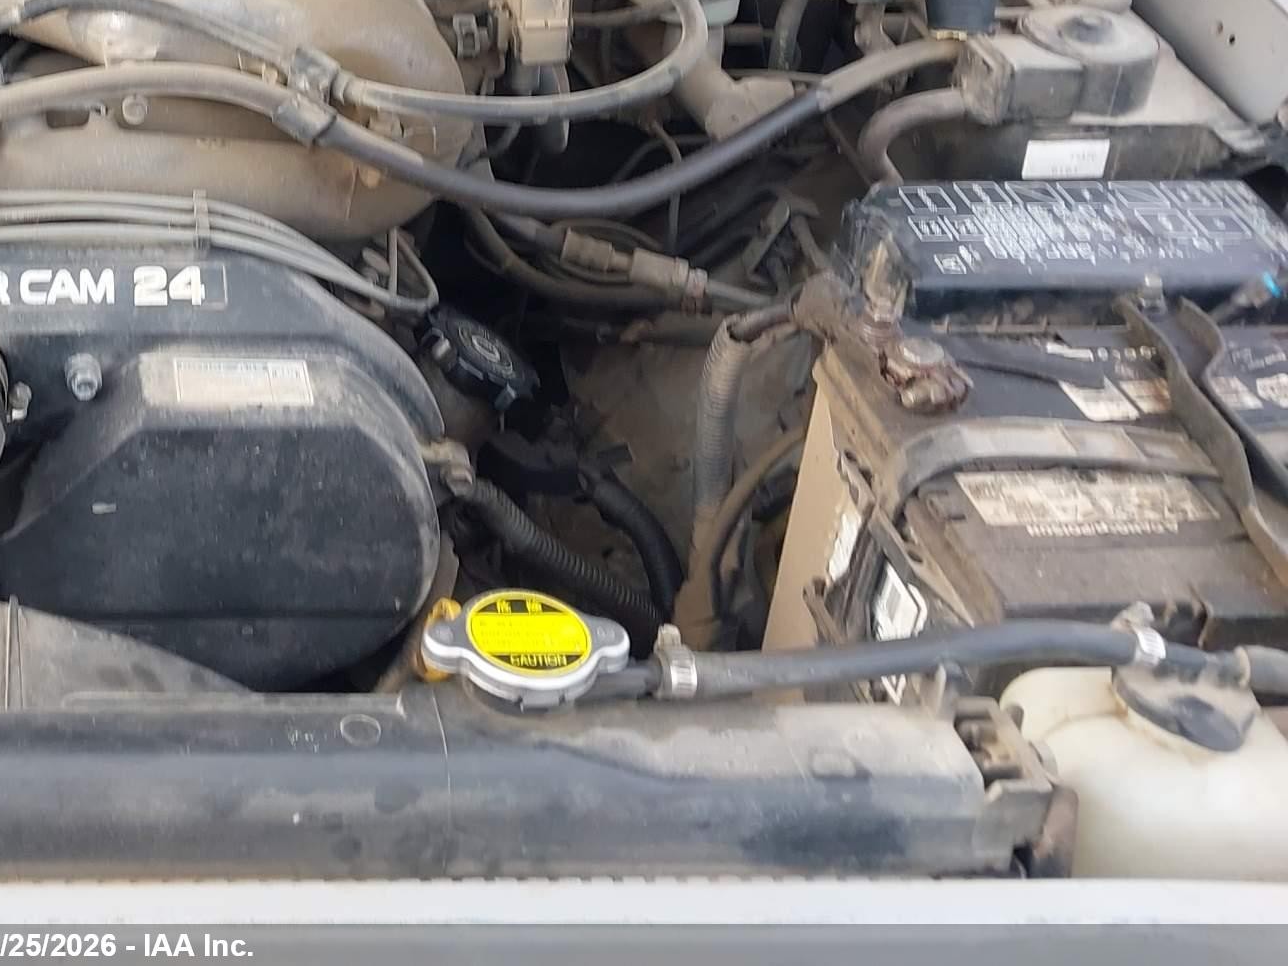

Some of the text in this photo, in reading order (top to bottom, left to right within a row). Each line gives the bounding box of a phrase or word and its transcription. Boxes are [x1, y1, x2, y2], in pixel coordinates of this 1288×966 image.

[20, 267, 115, 306] CAM
[133, 266, 206, 308] 24
[510, 653, 567, 668] CAUTION
